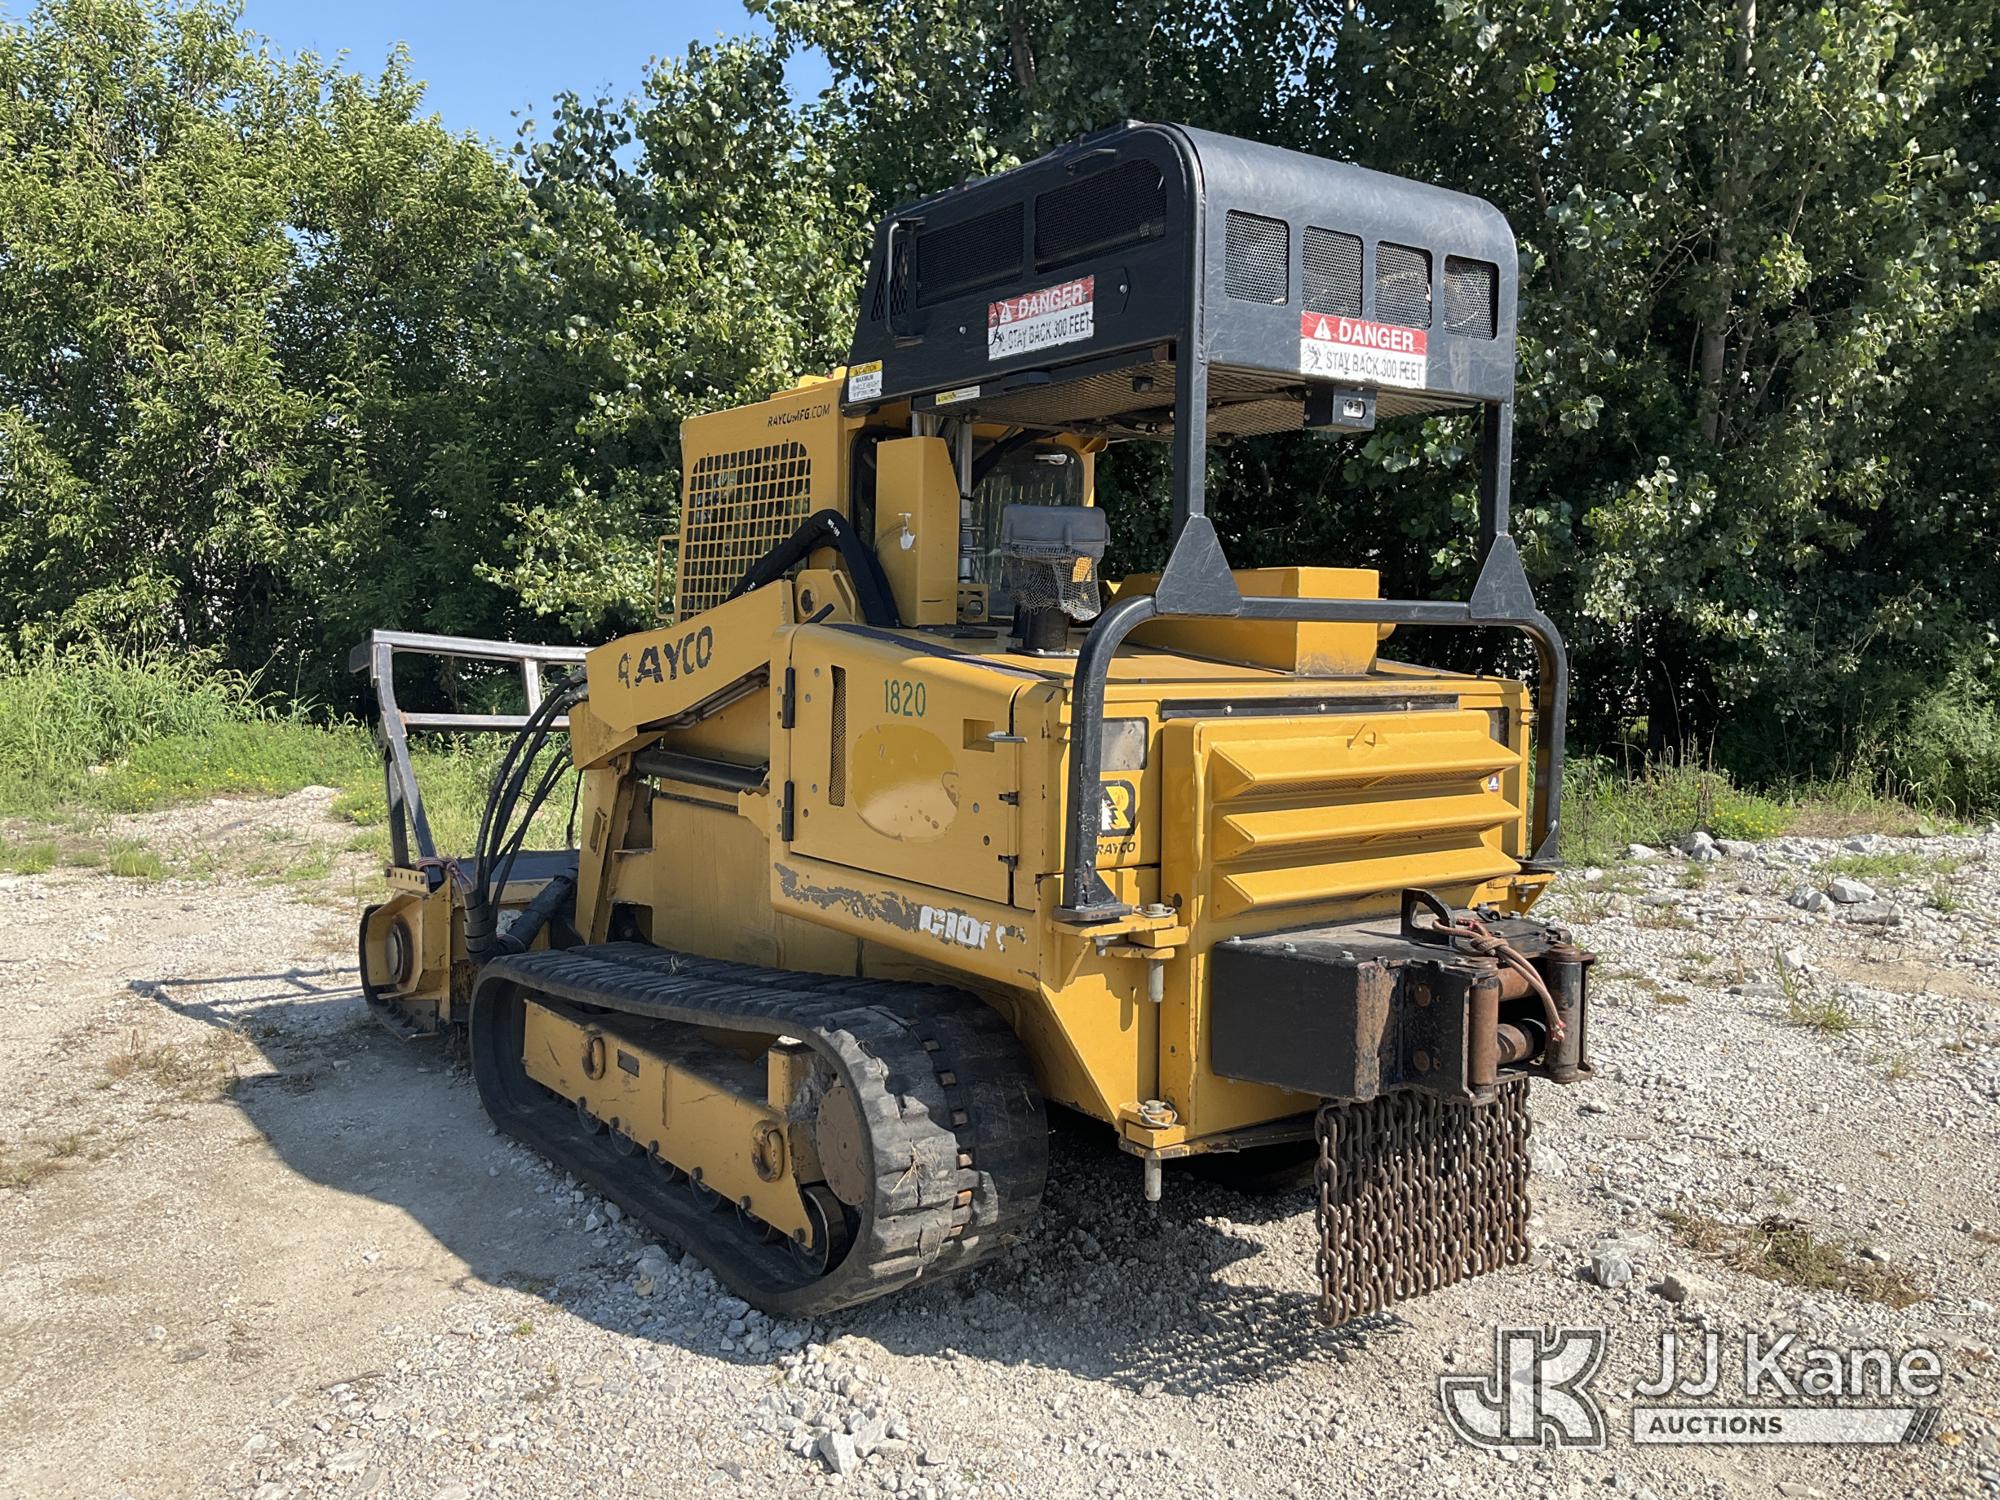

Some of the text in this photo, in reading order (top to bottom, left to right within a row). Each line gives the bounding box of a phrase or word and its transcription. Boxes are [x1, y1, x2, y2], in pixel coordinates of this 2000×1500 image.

[1018, 283, 1084, 319] DANGER
[1008, 311, 1089, 349] STAY BACK 300 FEET
[1338, 317, 1414, 352] DANGER
[1326, 351, 1423, 382] STAY BACK 300 FEET
[884, 679, 926, 718] 1820
[1097, 841, 1136, 855] RAYCO
